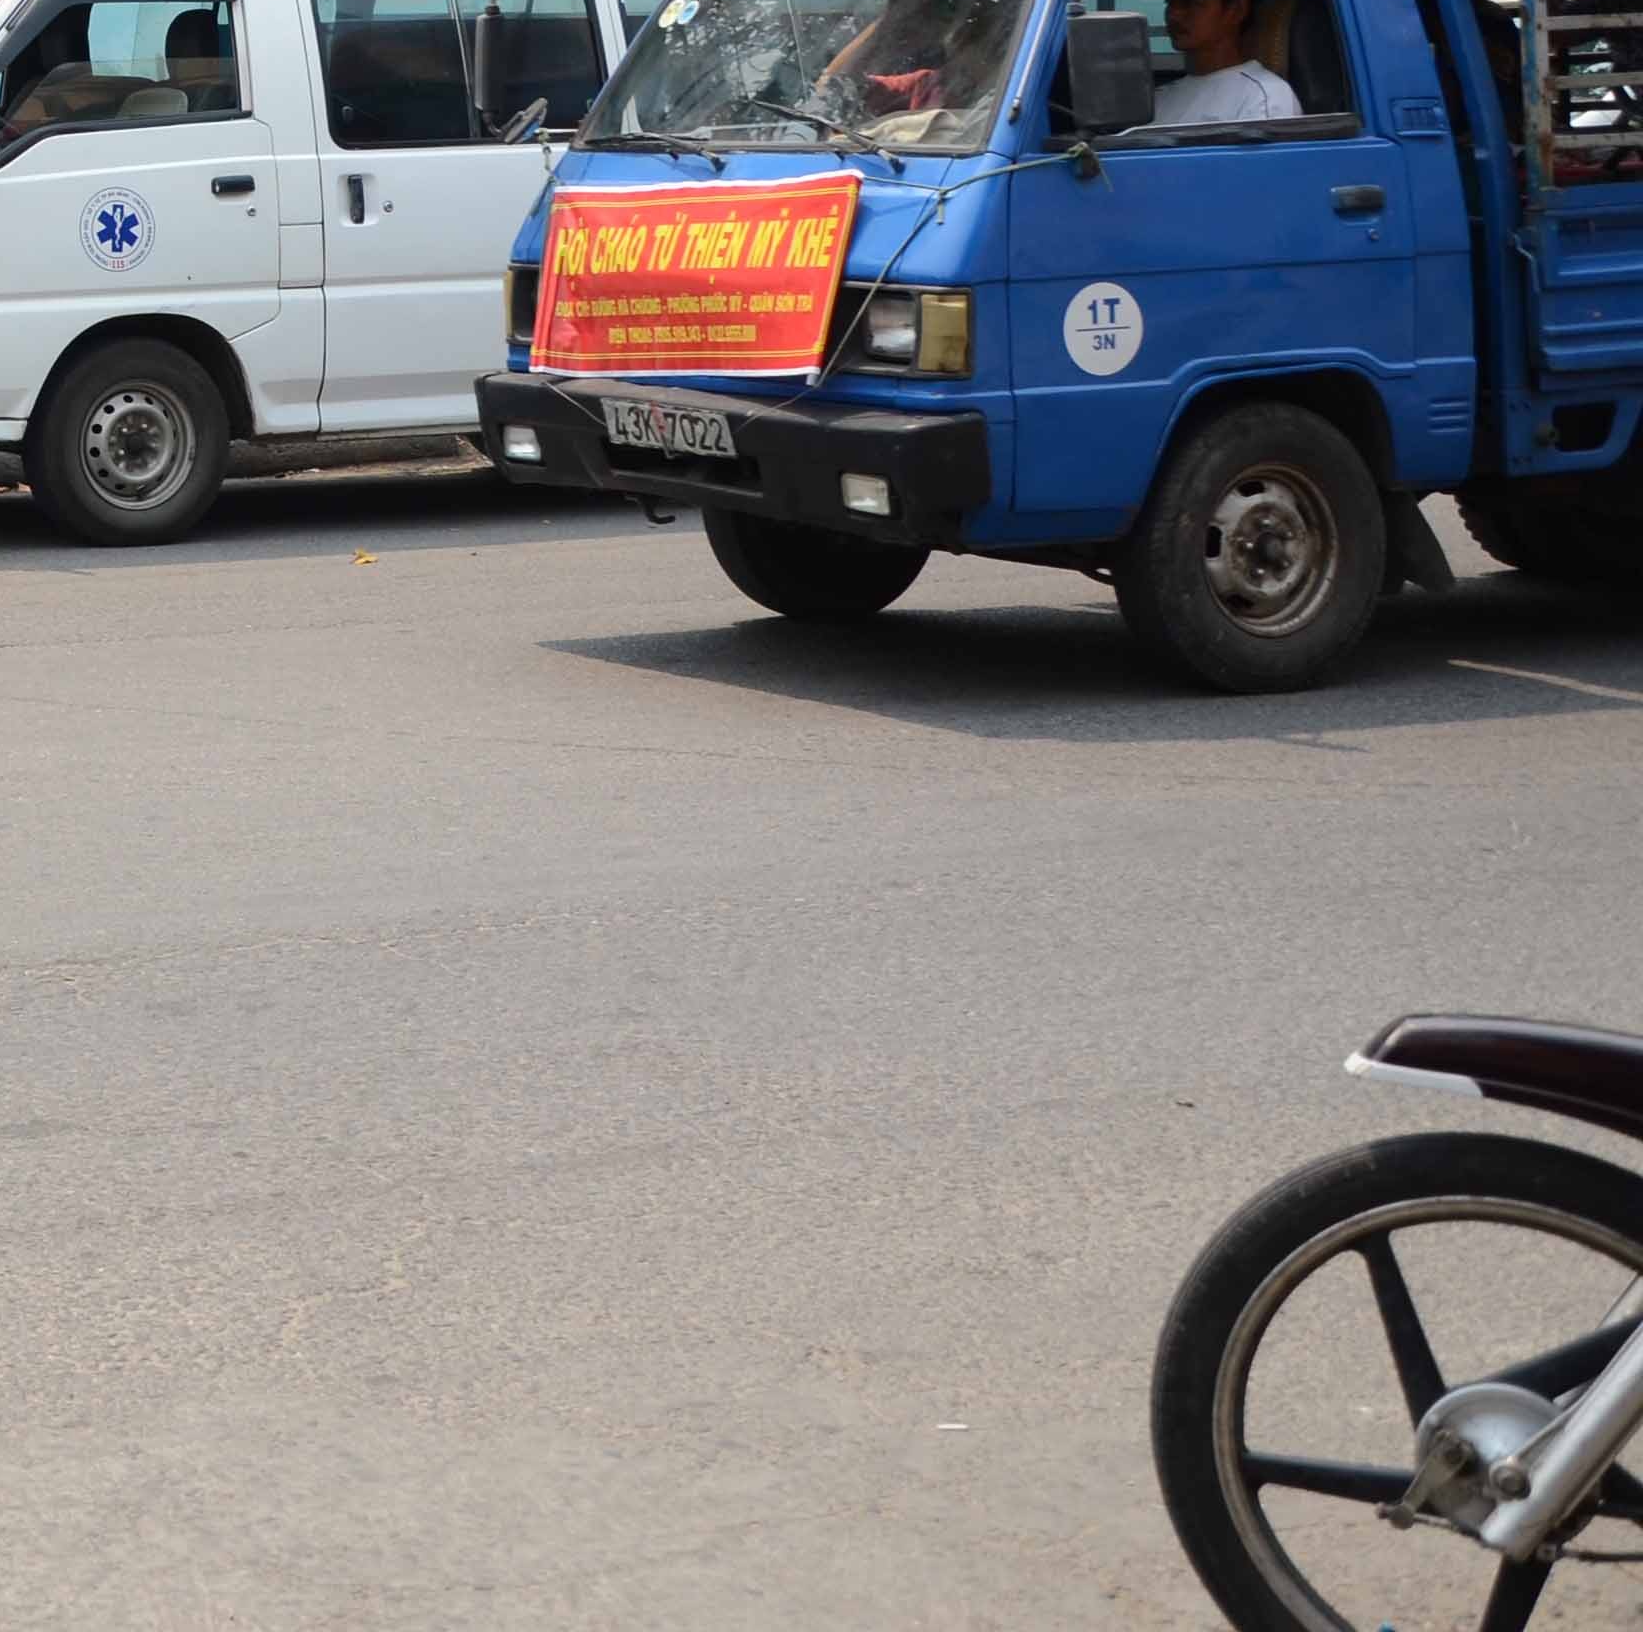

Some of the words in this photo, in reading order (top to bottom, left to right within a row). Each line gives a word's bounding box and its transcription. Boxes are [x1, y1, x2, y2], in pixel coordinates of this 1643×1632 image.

[591, 213, 649, 274] CHÁO
[680, 211, 750, 284] THIỆN
[785, 204, 839, 268] KHÊ
[1087, 297, 1121, 325] 1T
[1092, 333, 1117, 351] 3N
